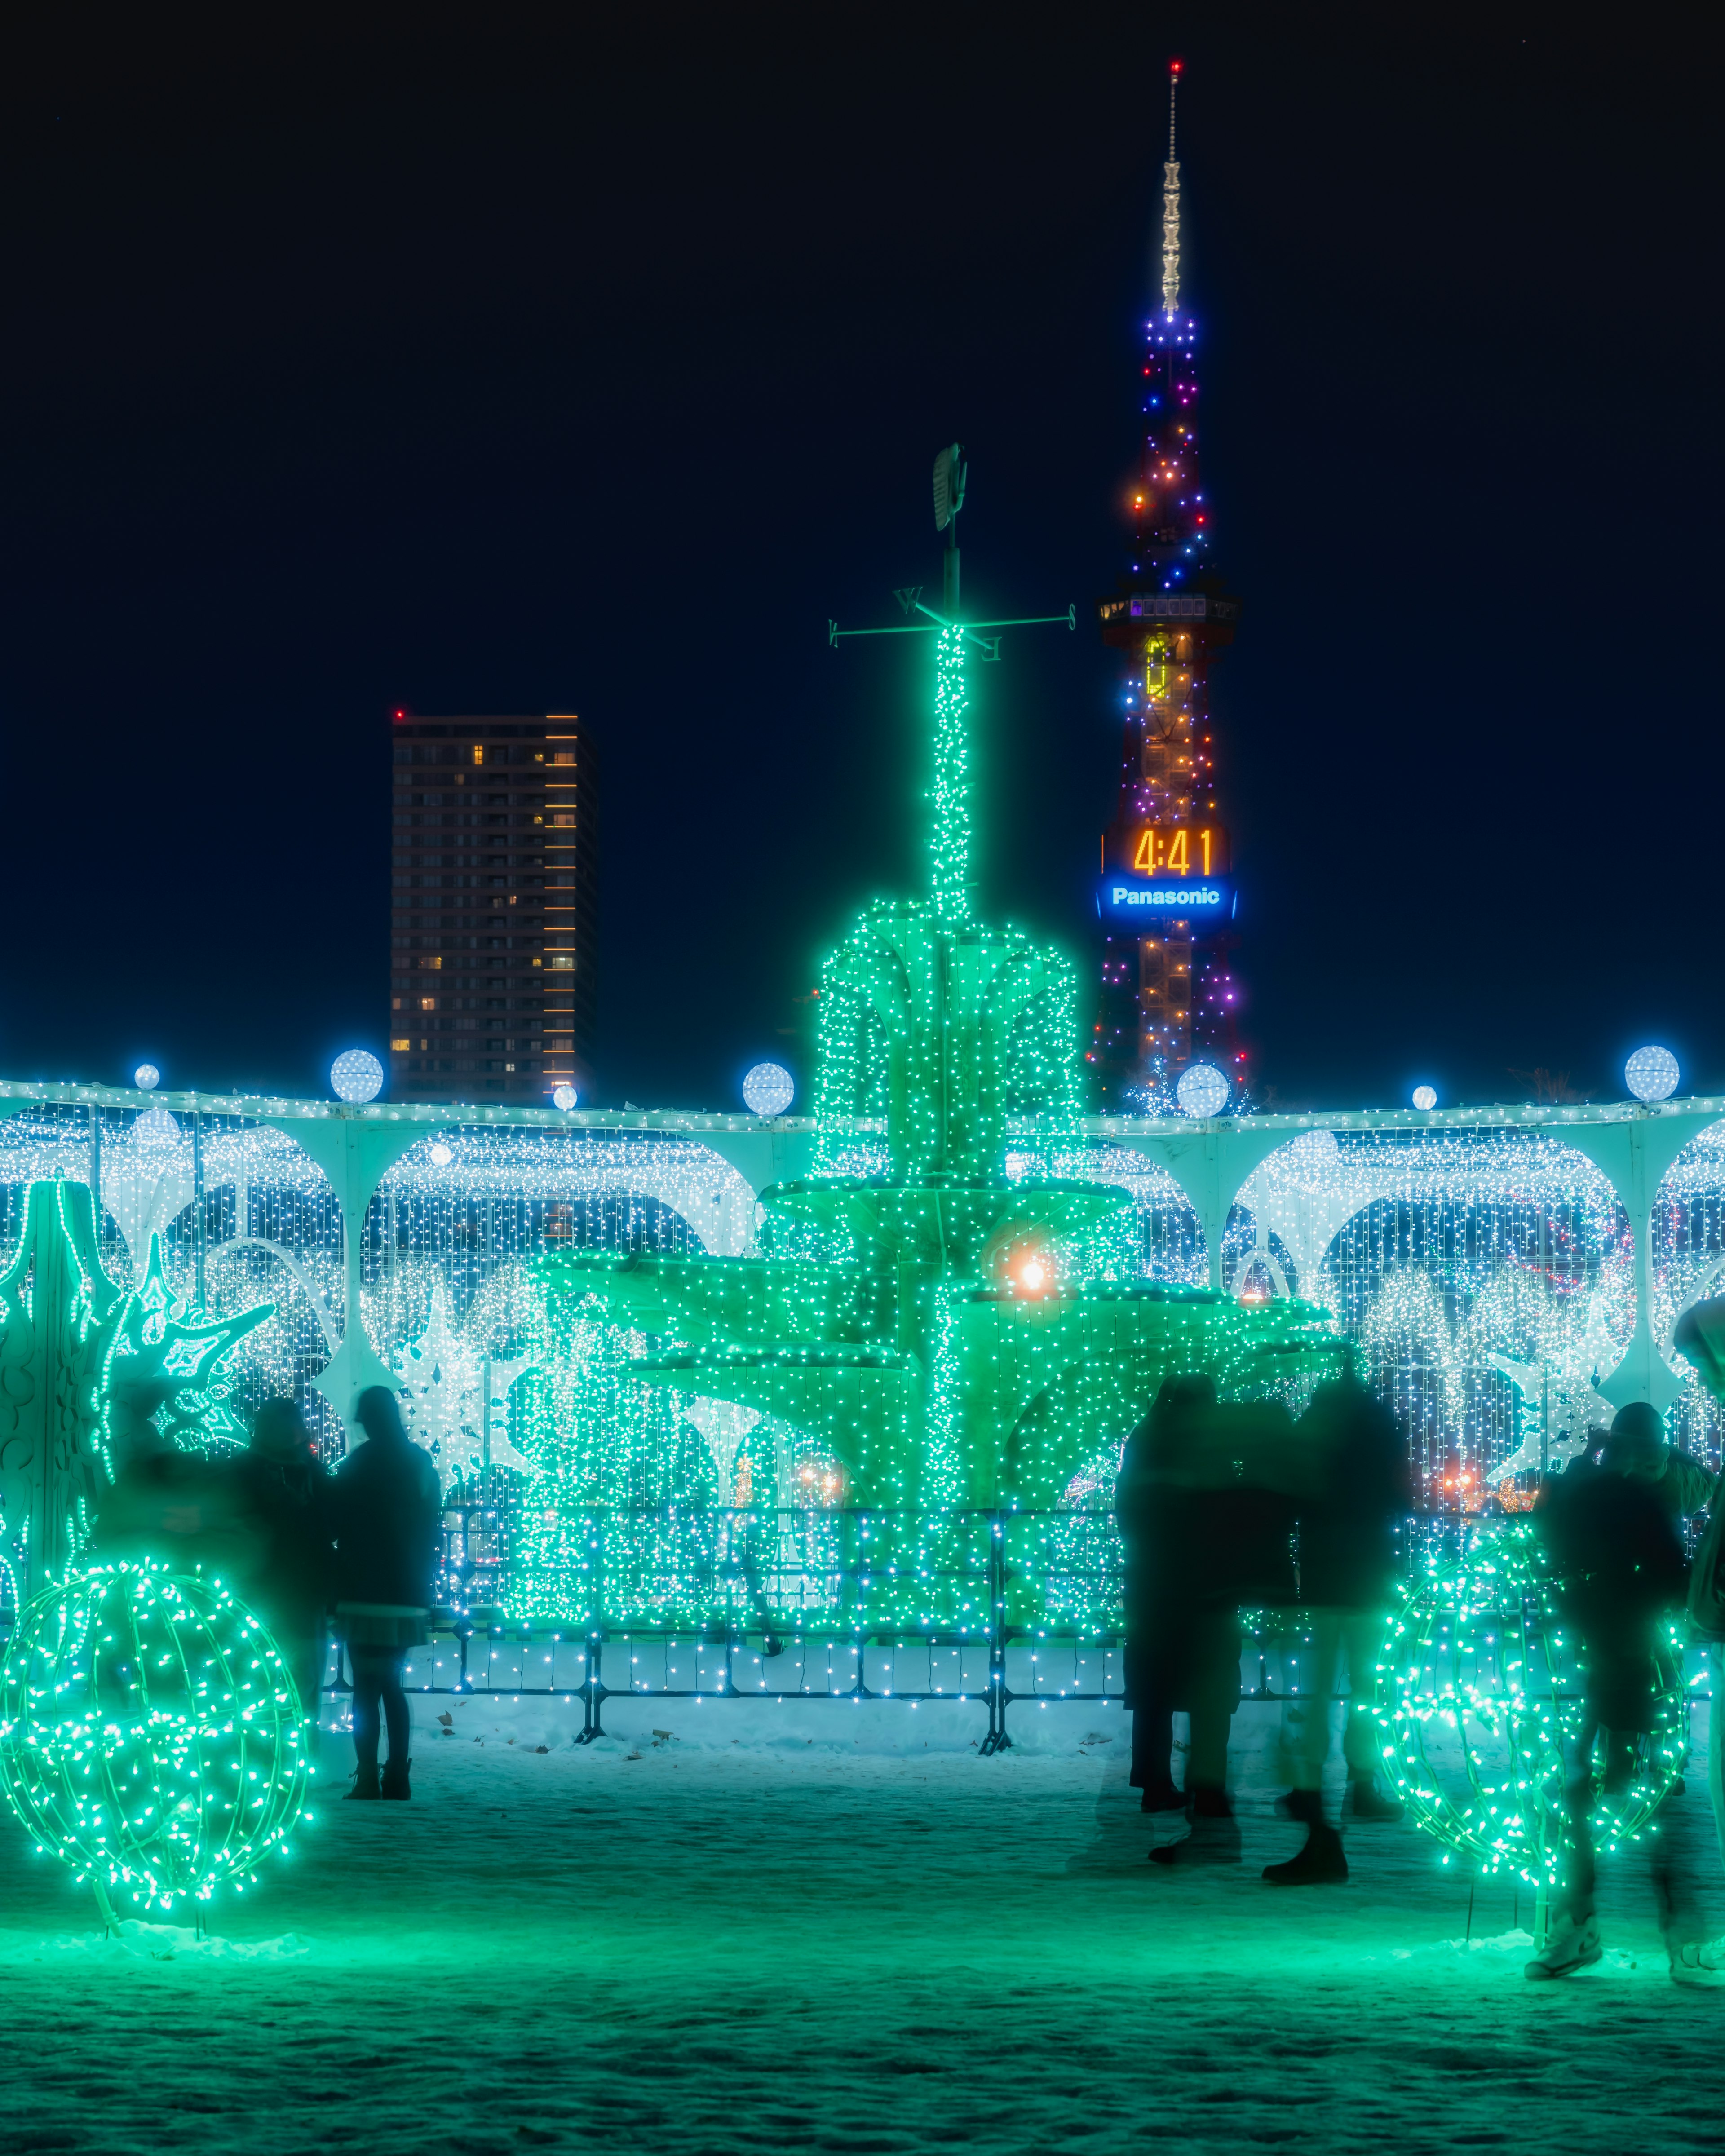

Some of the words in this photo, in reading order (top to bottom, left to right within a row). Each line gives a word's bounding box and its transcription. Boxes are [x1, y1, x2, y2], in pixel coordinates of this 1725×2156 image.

[892, 586, 923, 614] W
[1069, 603, 1075, 630] S
[1134, 830, 1210, 876] 4:41
[1113, 887, 1220, 905] Panasonic
